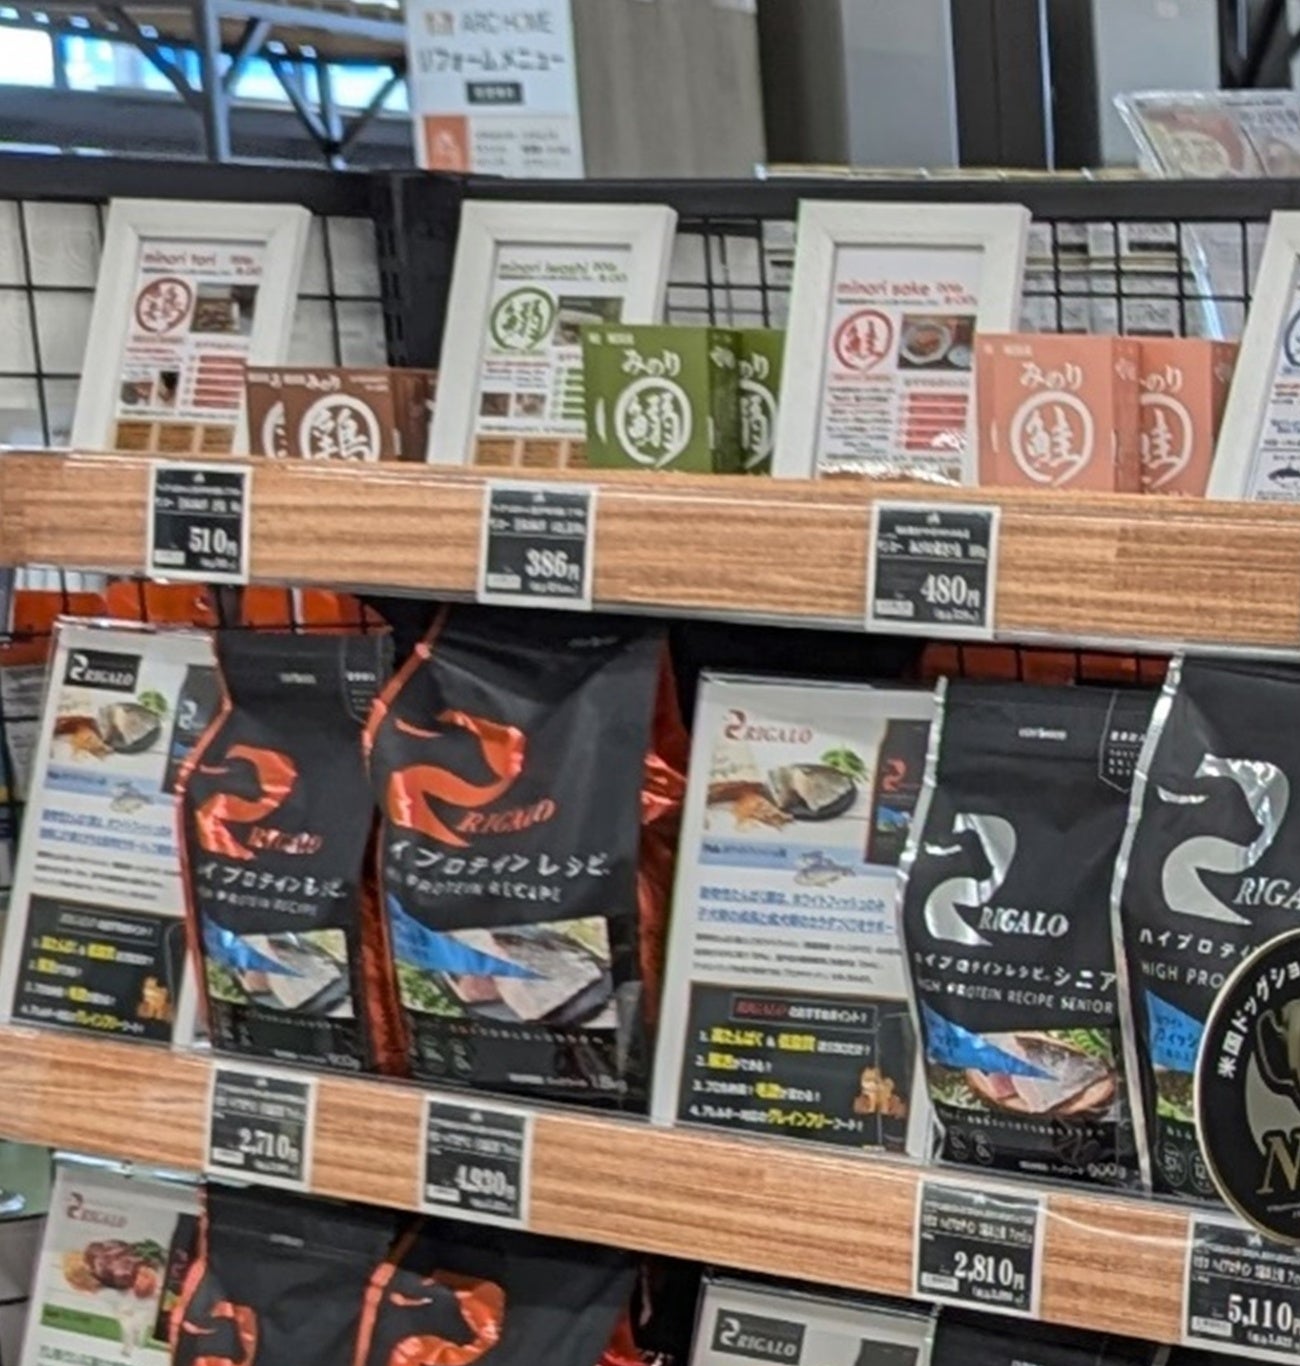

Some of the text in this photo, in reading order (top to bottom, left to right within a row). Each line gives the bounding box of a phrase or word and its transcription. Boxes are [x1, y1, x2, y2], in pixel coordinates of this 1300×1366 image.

[1020, 361, 1082, 388] みのり
[189, 527, 239, 558] 510円
[920, 574, 982, 608] 480円
[979, 905, 1070, 939] RIGALO
[1053, 967, 1117, 992] シニア
[951, 1249, 1025, 1289] 2,810円
[737, 1333, 797, 1359] RIGALO
